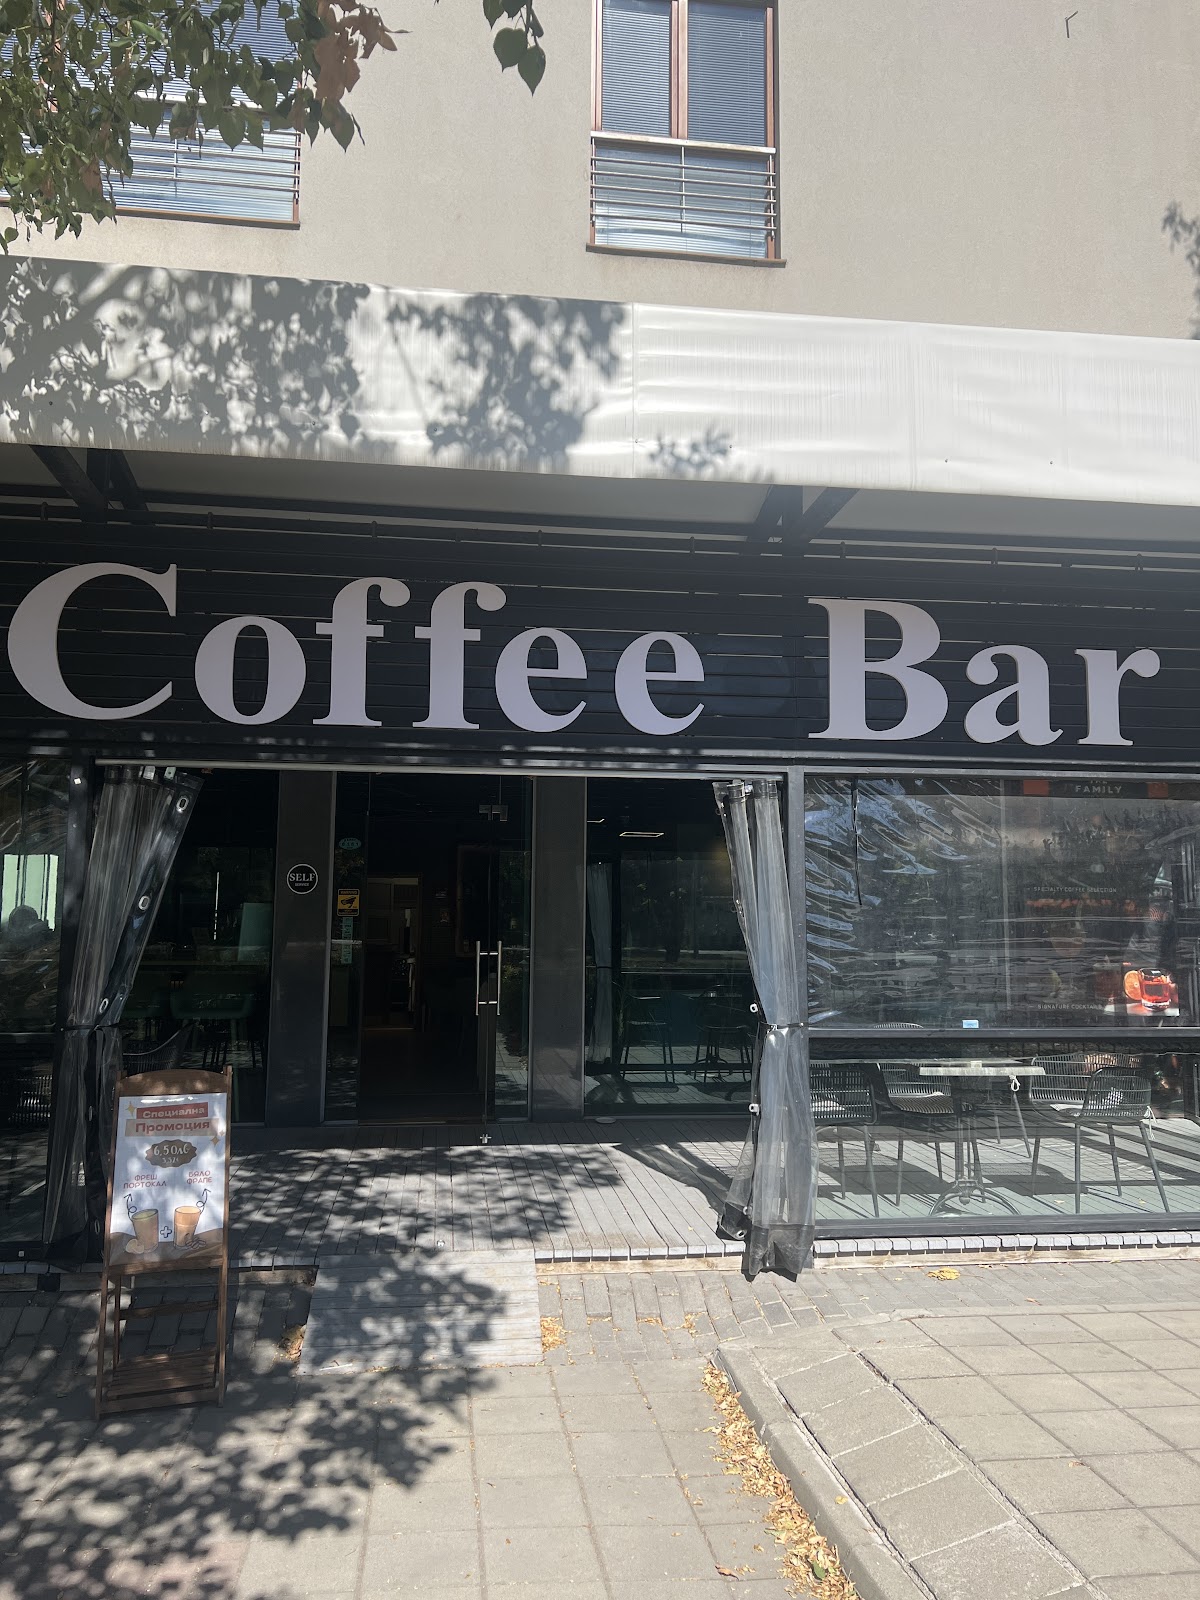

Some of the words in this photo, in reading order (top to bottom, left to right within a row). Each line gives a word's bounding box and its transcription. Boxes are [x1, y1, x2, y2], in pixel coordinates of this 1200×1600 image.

[8, 562, 705, 736] Coffee
[808, 597, 1161, 747] Bar
[1075, 785, 1122, 794] FAMILY
[289, 873, 316, 882] SELF
[142, 1107, 205, 1119] Специална
[135, 1121, 210, 1134] Промоция
[188, 1170, 211, 1178] БЯЛО
[123, 1180, 167, 1189] ПОРТОКАЛ
